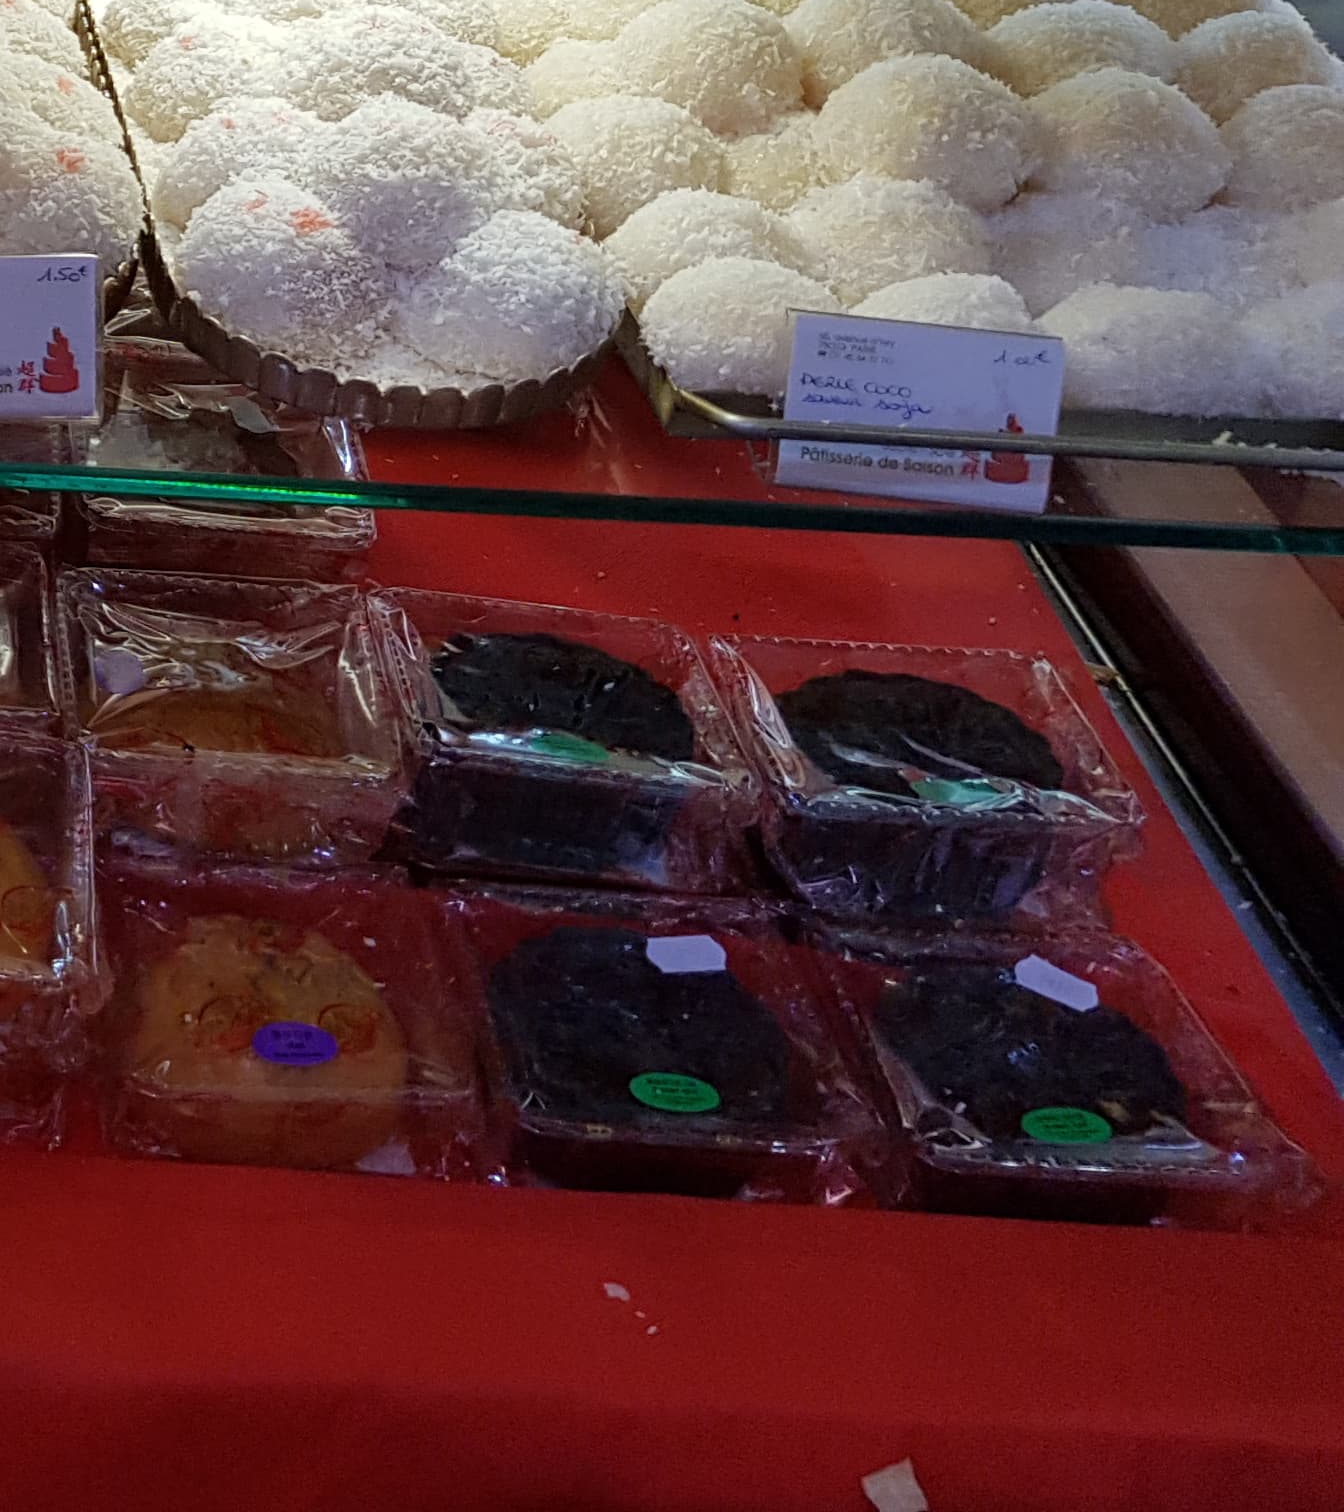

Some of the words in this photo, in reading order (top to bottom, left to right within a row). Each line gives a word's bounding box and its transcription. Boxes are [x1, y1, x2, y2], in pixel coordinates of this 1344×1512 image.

[863, 382, 912, 398] COCO
[873, 398, 934, 420] soja
[800, 446, 872, 468] Pâtisserie
[878, 459, 899, 471] de
[903, 461, 954, 476] Saison
